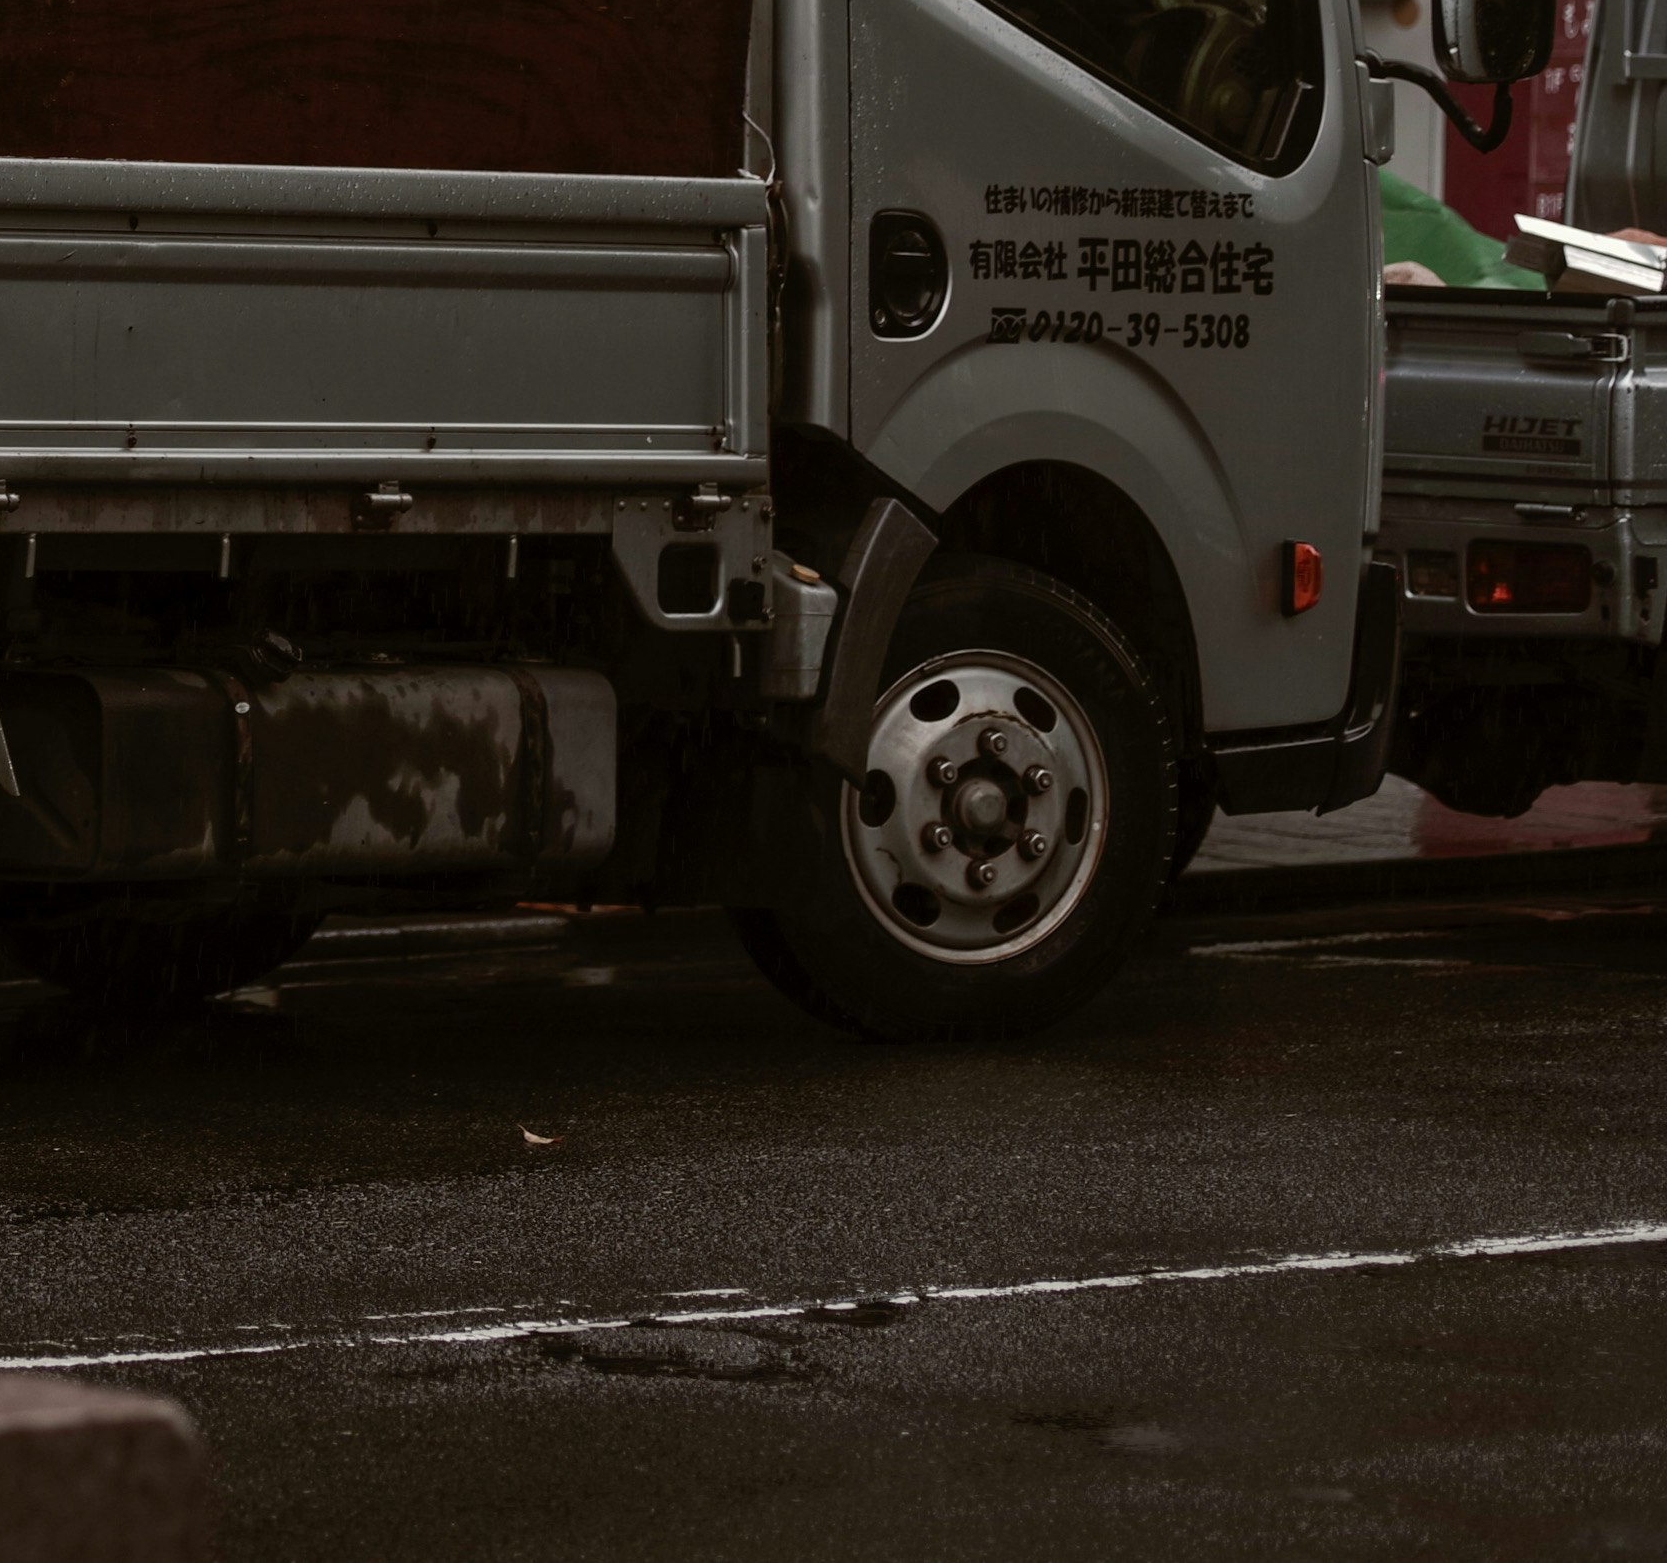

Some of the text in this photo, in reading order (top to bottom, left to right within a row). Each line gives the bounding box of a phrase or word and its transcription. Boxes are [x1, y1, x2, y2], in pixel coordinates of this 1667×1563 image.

[985, 185, 1254, 219] 住まいの補修から新築建て替えまで
[969, 237, 1274, 295] 有限会社 平田総合住宅
[1028, 310, 1250, 348] 0120-39-5308
[1482, 416, 1582, 436] HIJET
[1499, 437, 1564, 453] DAIHATSU
